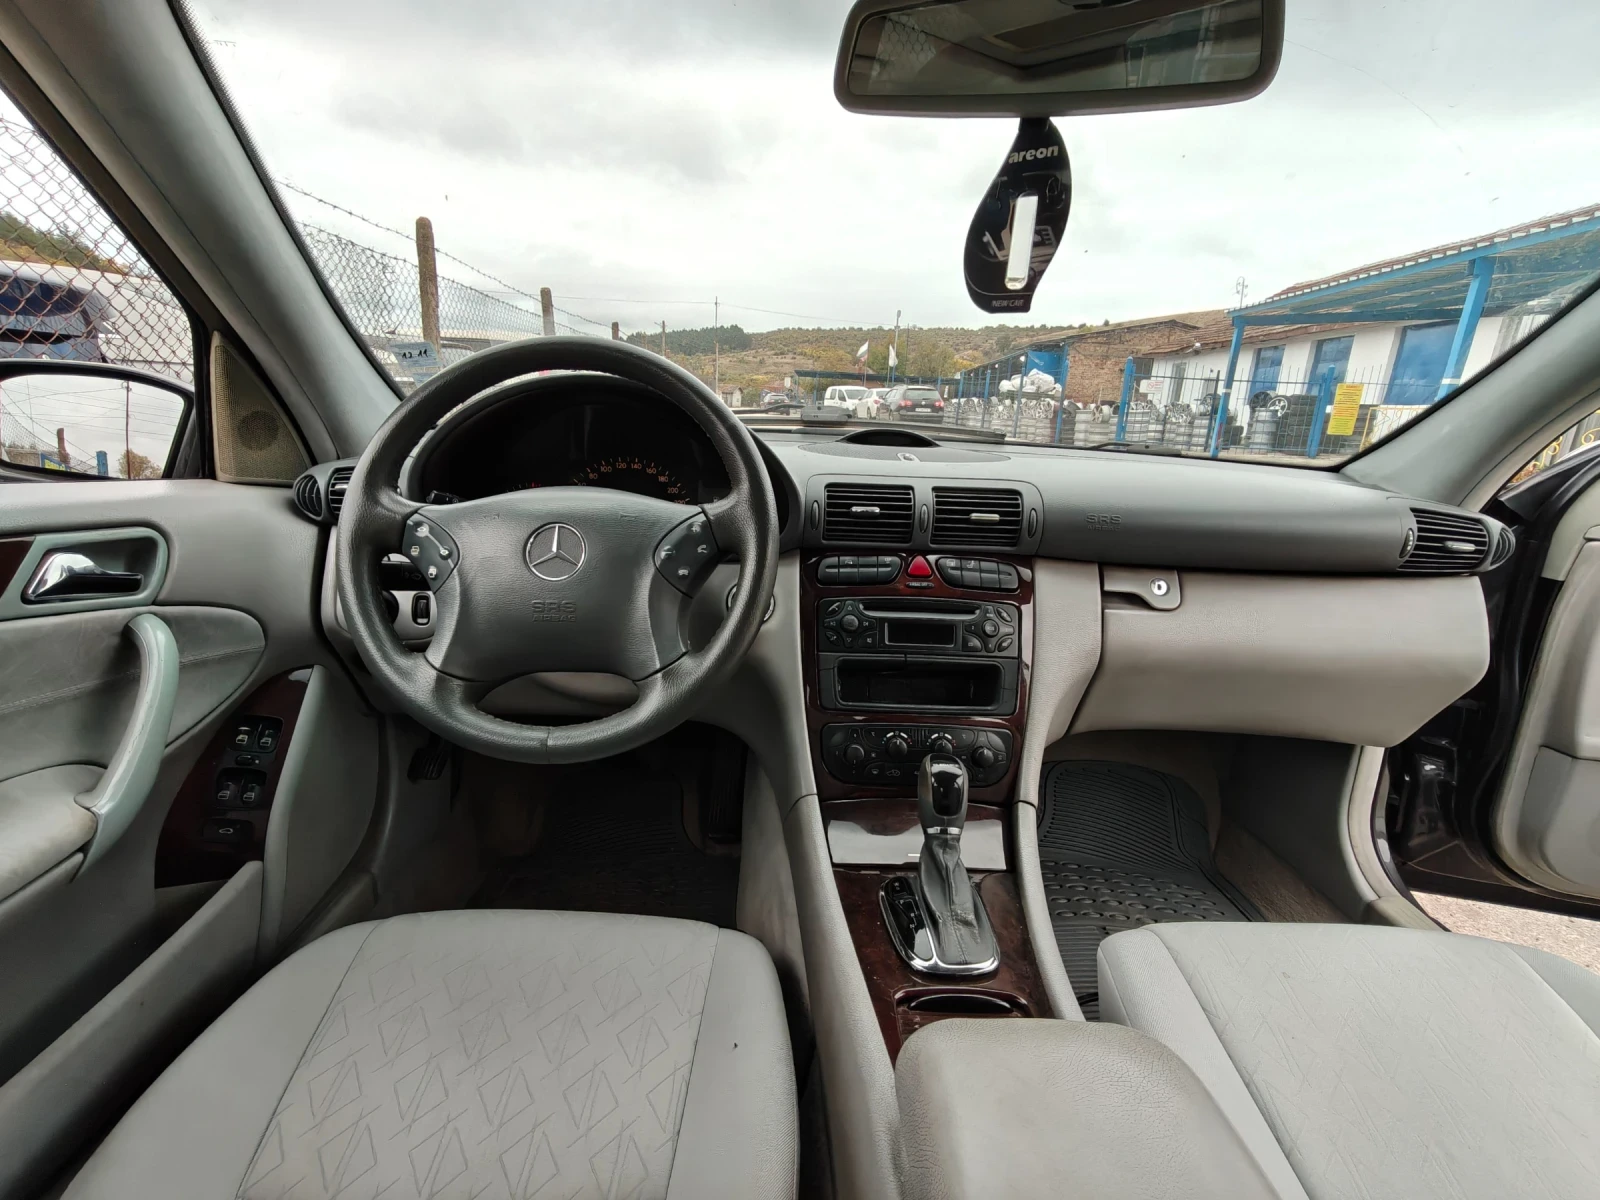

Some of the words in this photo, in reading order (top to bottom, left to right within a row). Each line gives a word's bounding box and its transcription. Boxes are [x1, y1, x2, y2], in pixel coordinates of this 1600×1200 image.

[1008, 145, 1059, 164] areon
[1085, 512, 1122, 524] SRS
[531, 599, 576, 612] SRS
